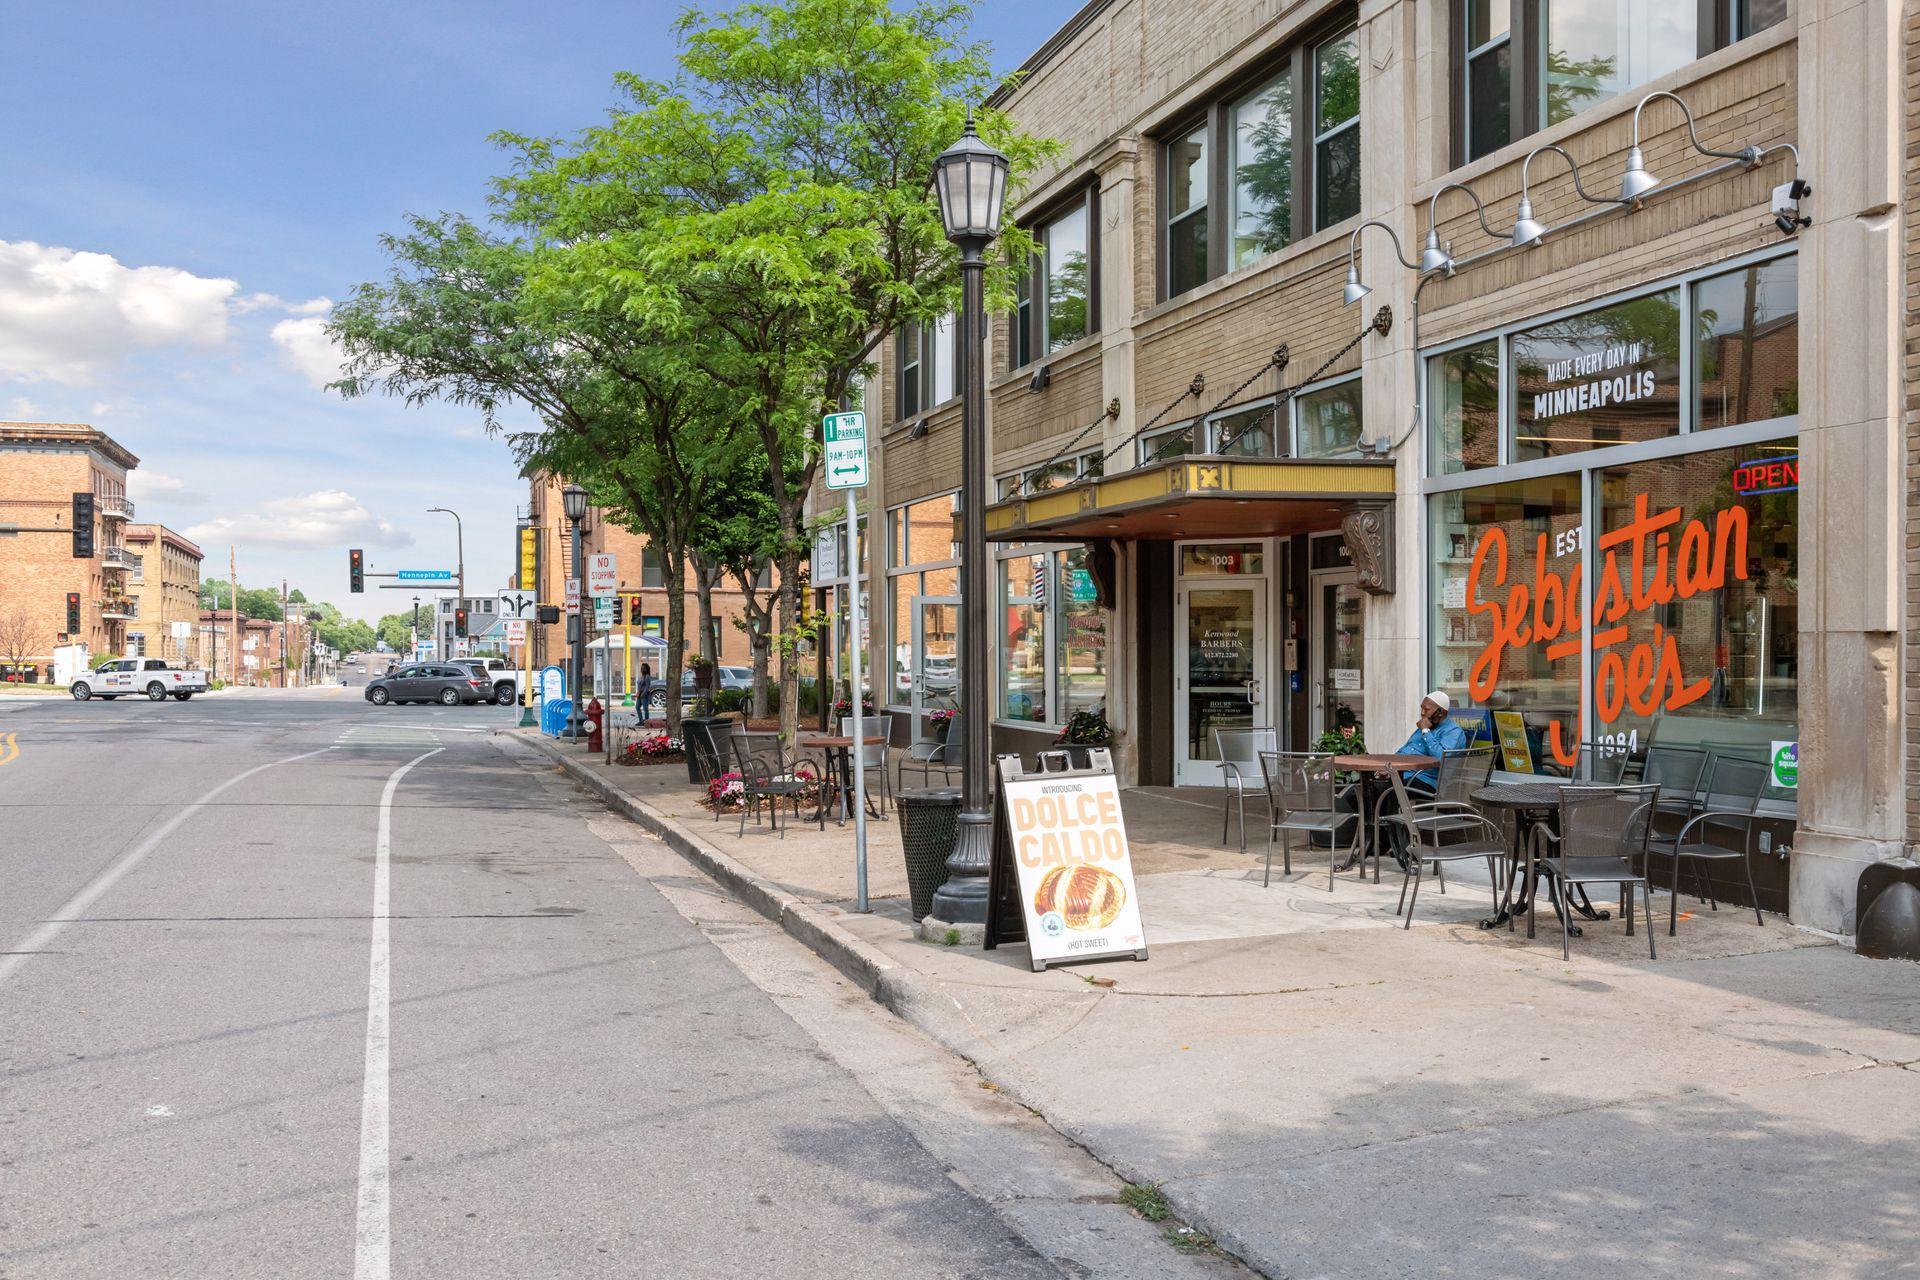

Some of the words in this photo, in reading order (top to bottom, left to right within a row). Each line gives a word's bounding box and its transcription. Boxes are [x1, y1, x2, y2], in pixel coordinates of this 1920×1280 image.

[1547, 359, 1572, 383] MADE
[1575, 351, 1604, 377] EVERY
[1607, 345, 1626, 369] DAY
[1629, 342, 1640, 364] IN
[1534, 370, 1655, 420] MINNEAPOLIS
[845, 416, 856, 426] HR
[828, 420, 833, 438] 1
[837, 427, 864, 438] PARKING
[829, 448, 864, 461] 9AM-10PM
[1733, 461, 1798, 491] OPEN
[1339, 546, 1351, 557] 100
[597, 557, 609, 567] NO
[1211, 555, 1234, 566] 1003
[401, 572, 435, 580] Hennepin
[591, 571, 615, 579] STOPPING
[569, 582, 576, 590] NO
[1204, 629, 1239, 638] Kenwood
[1200, 640, 1243, 648] BARBERS
[1598, 729, 1637, 759] 1984
[1041, 783, 1082, 794] INTRODUCING
[1012, 791, 1118, 831] DOLCE
[1019, 828, 1125, 868] CALDO
[1067, 939, 1083, 951] (HOT
[1084, 937, 1109, 949] SWEET)
